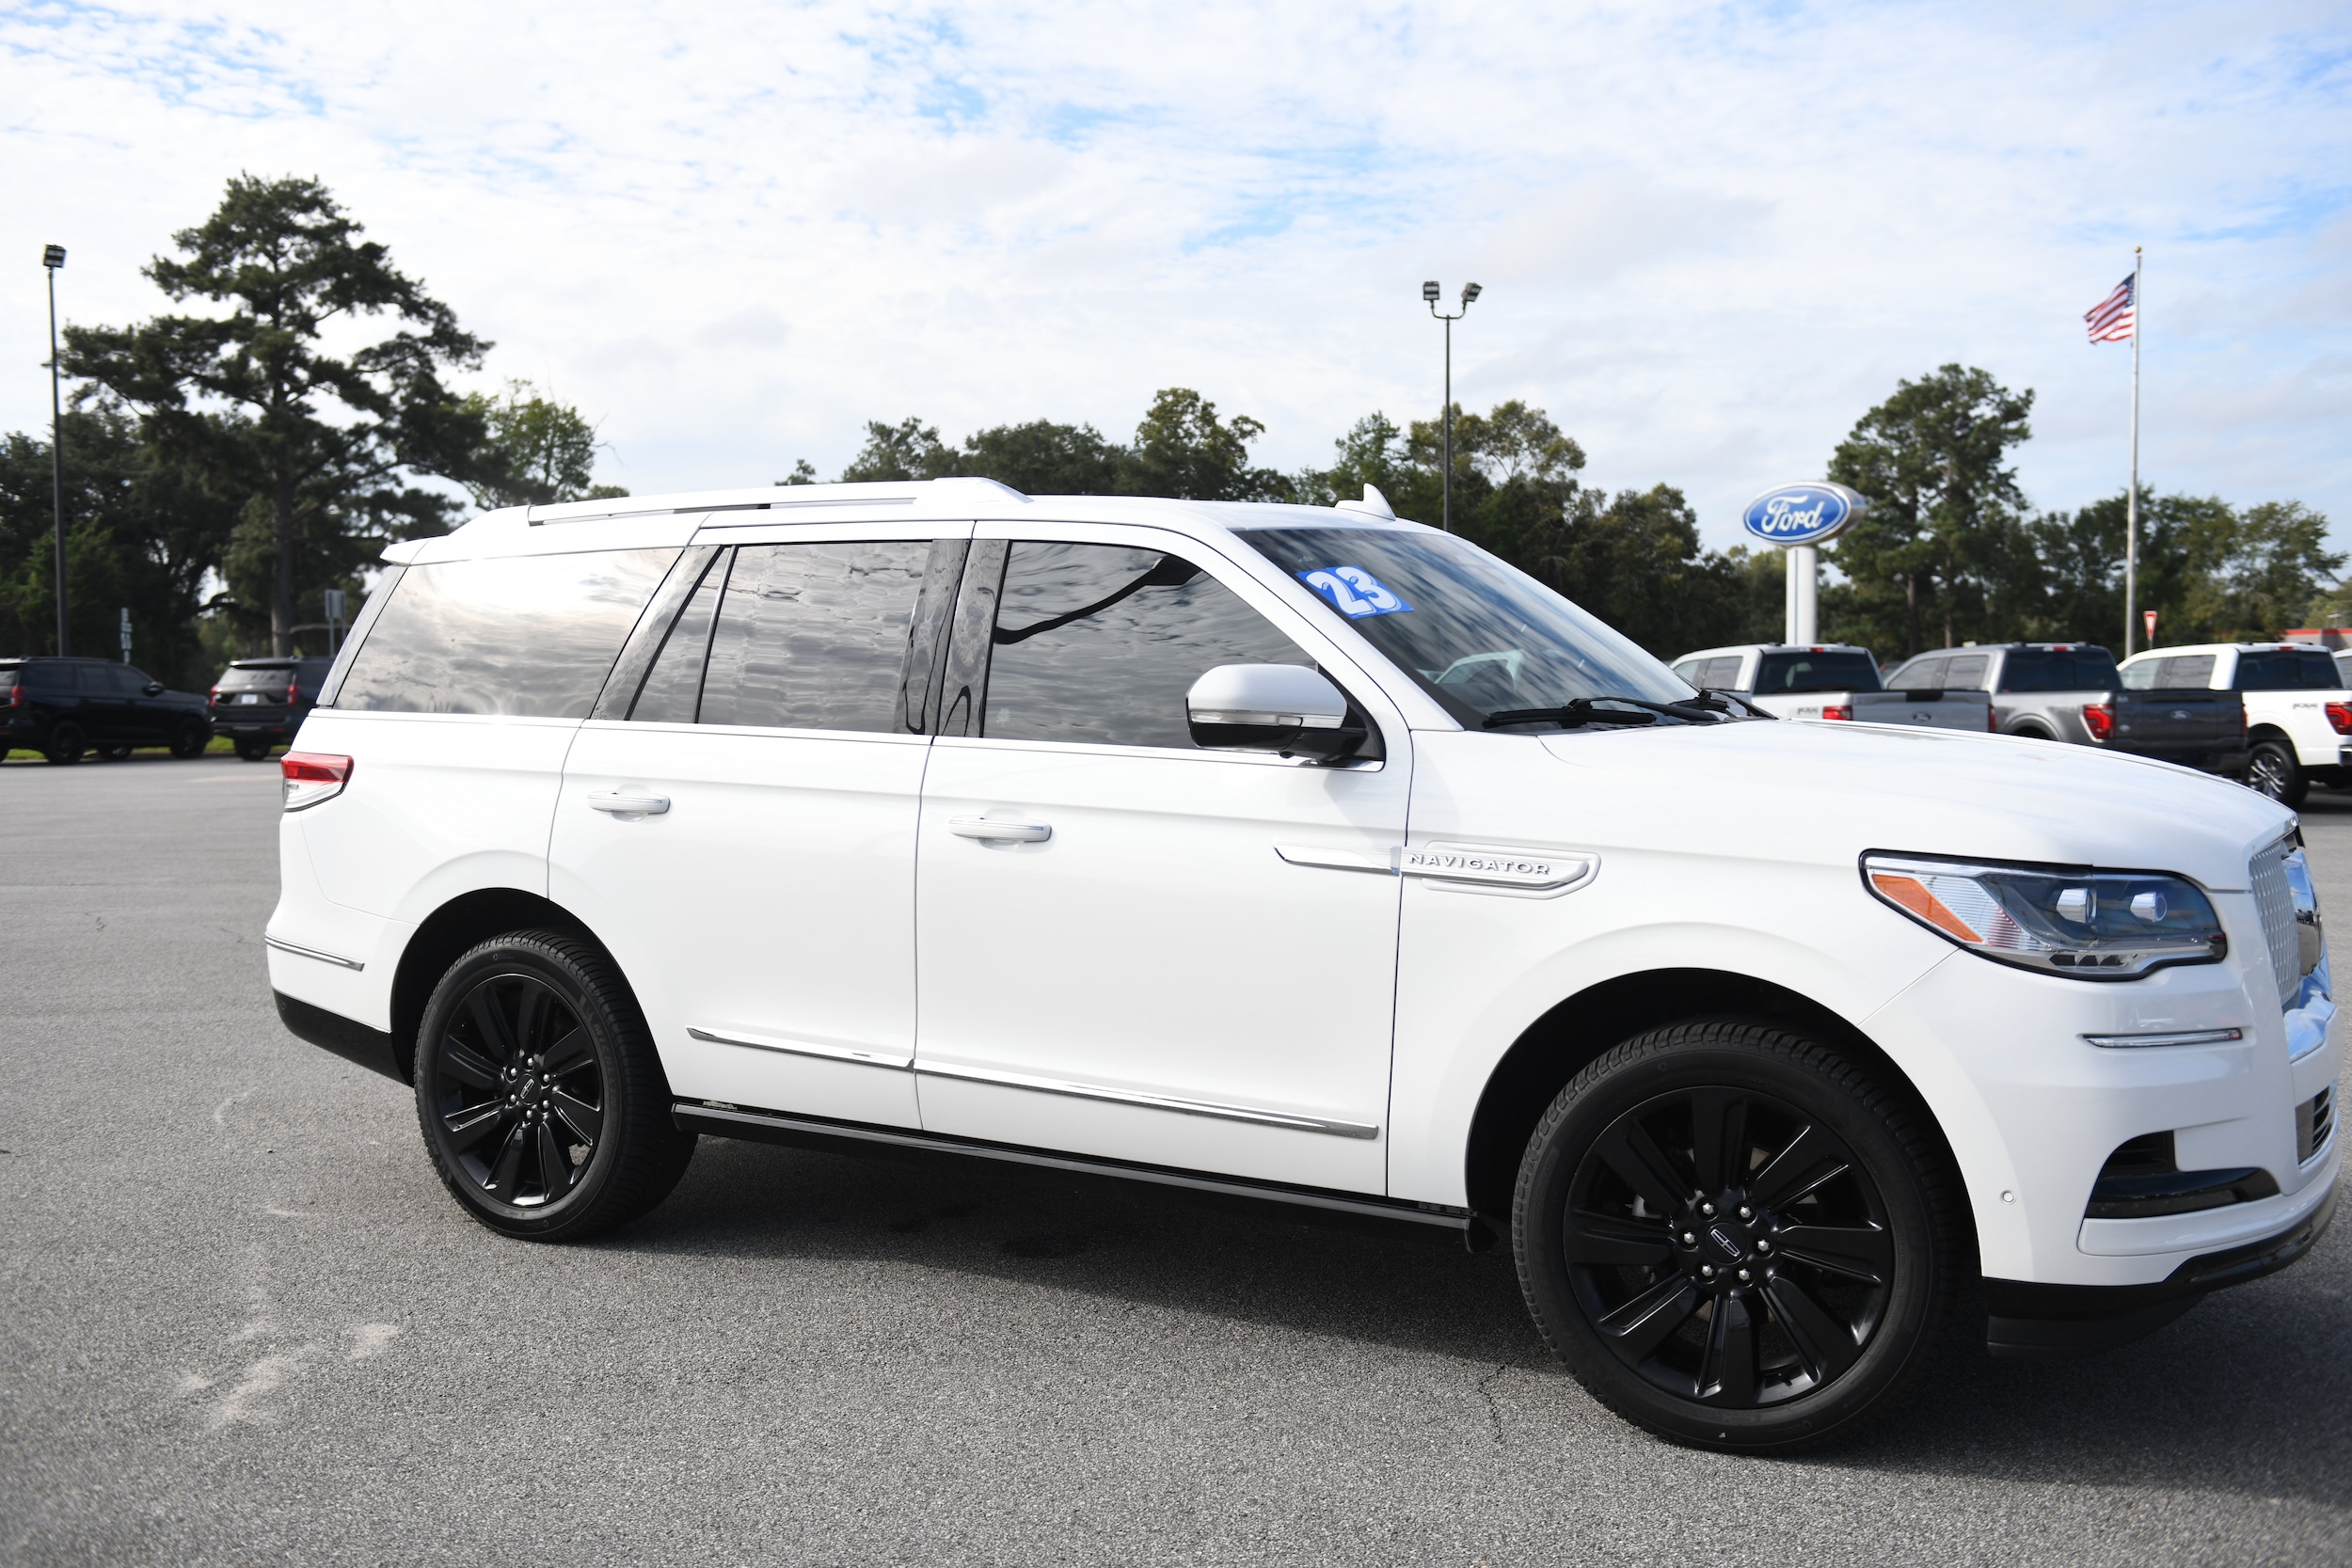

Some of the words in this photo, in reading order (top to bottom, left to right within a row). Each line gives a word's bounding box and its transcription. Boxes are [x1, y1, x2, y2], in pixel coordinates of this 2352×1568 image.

[1761, 494, 1825, 533] Ford
[1306, 566, 1402, 615] 23
[1409, 853, 1550, 876] NAVIGATOR
